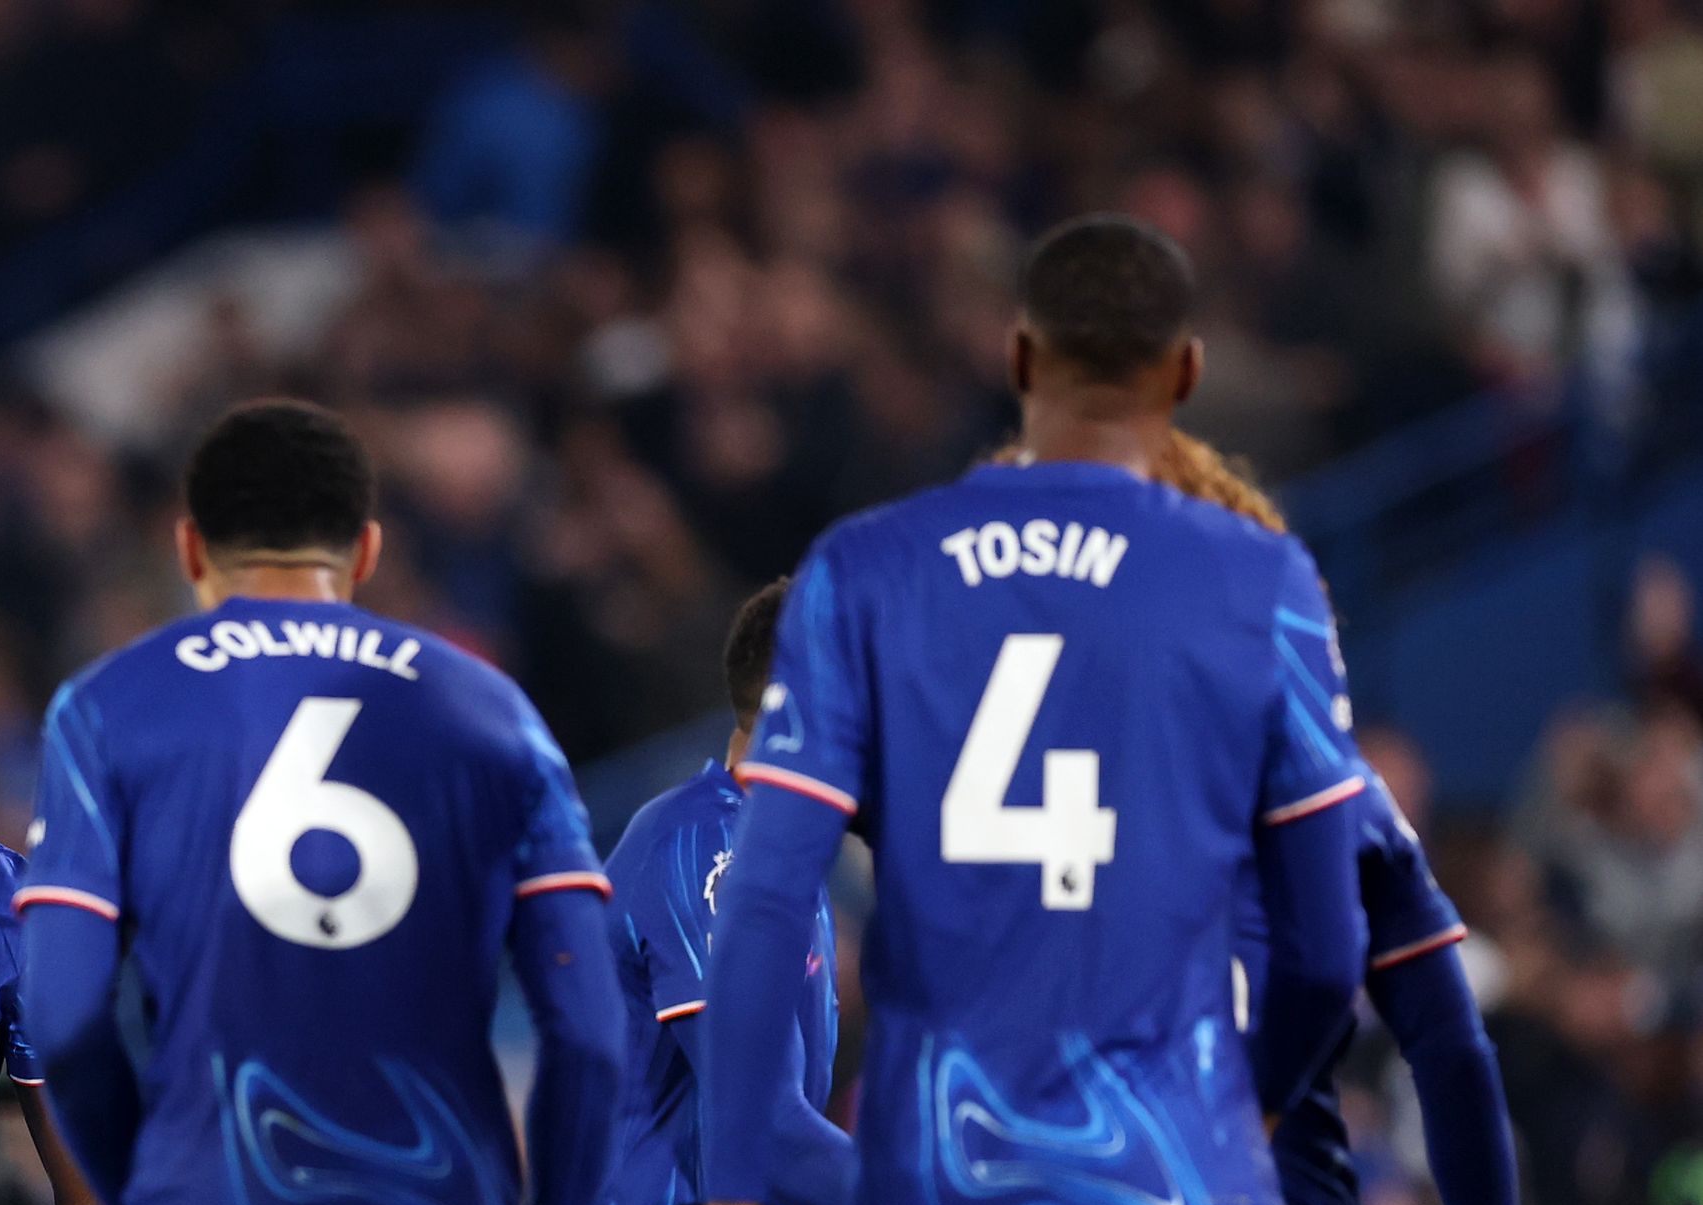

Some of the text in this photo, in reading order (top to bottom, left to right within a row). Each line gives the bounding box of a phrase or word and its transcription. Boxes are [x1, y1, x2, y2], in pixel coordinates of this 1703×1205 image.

[940, 518, 1129, 588] TOSIN
[174, 620, 421, 682] COLWILL
[229, 696, 419, 950] 6
[940, 633, 1117, 911] 4
